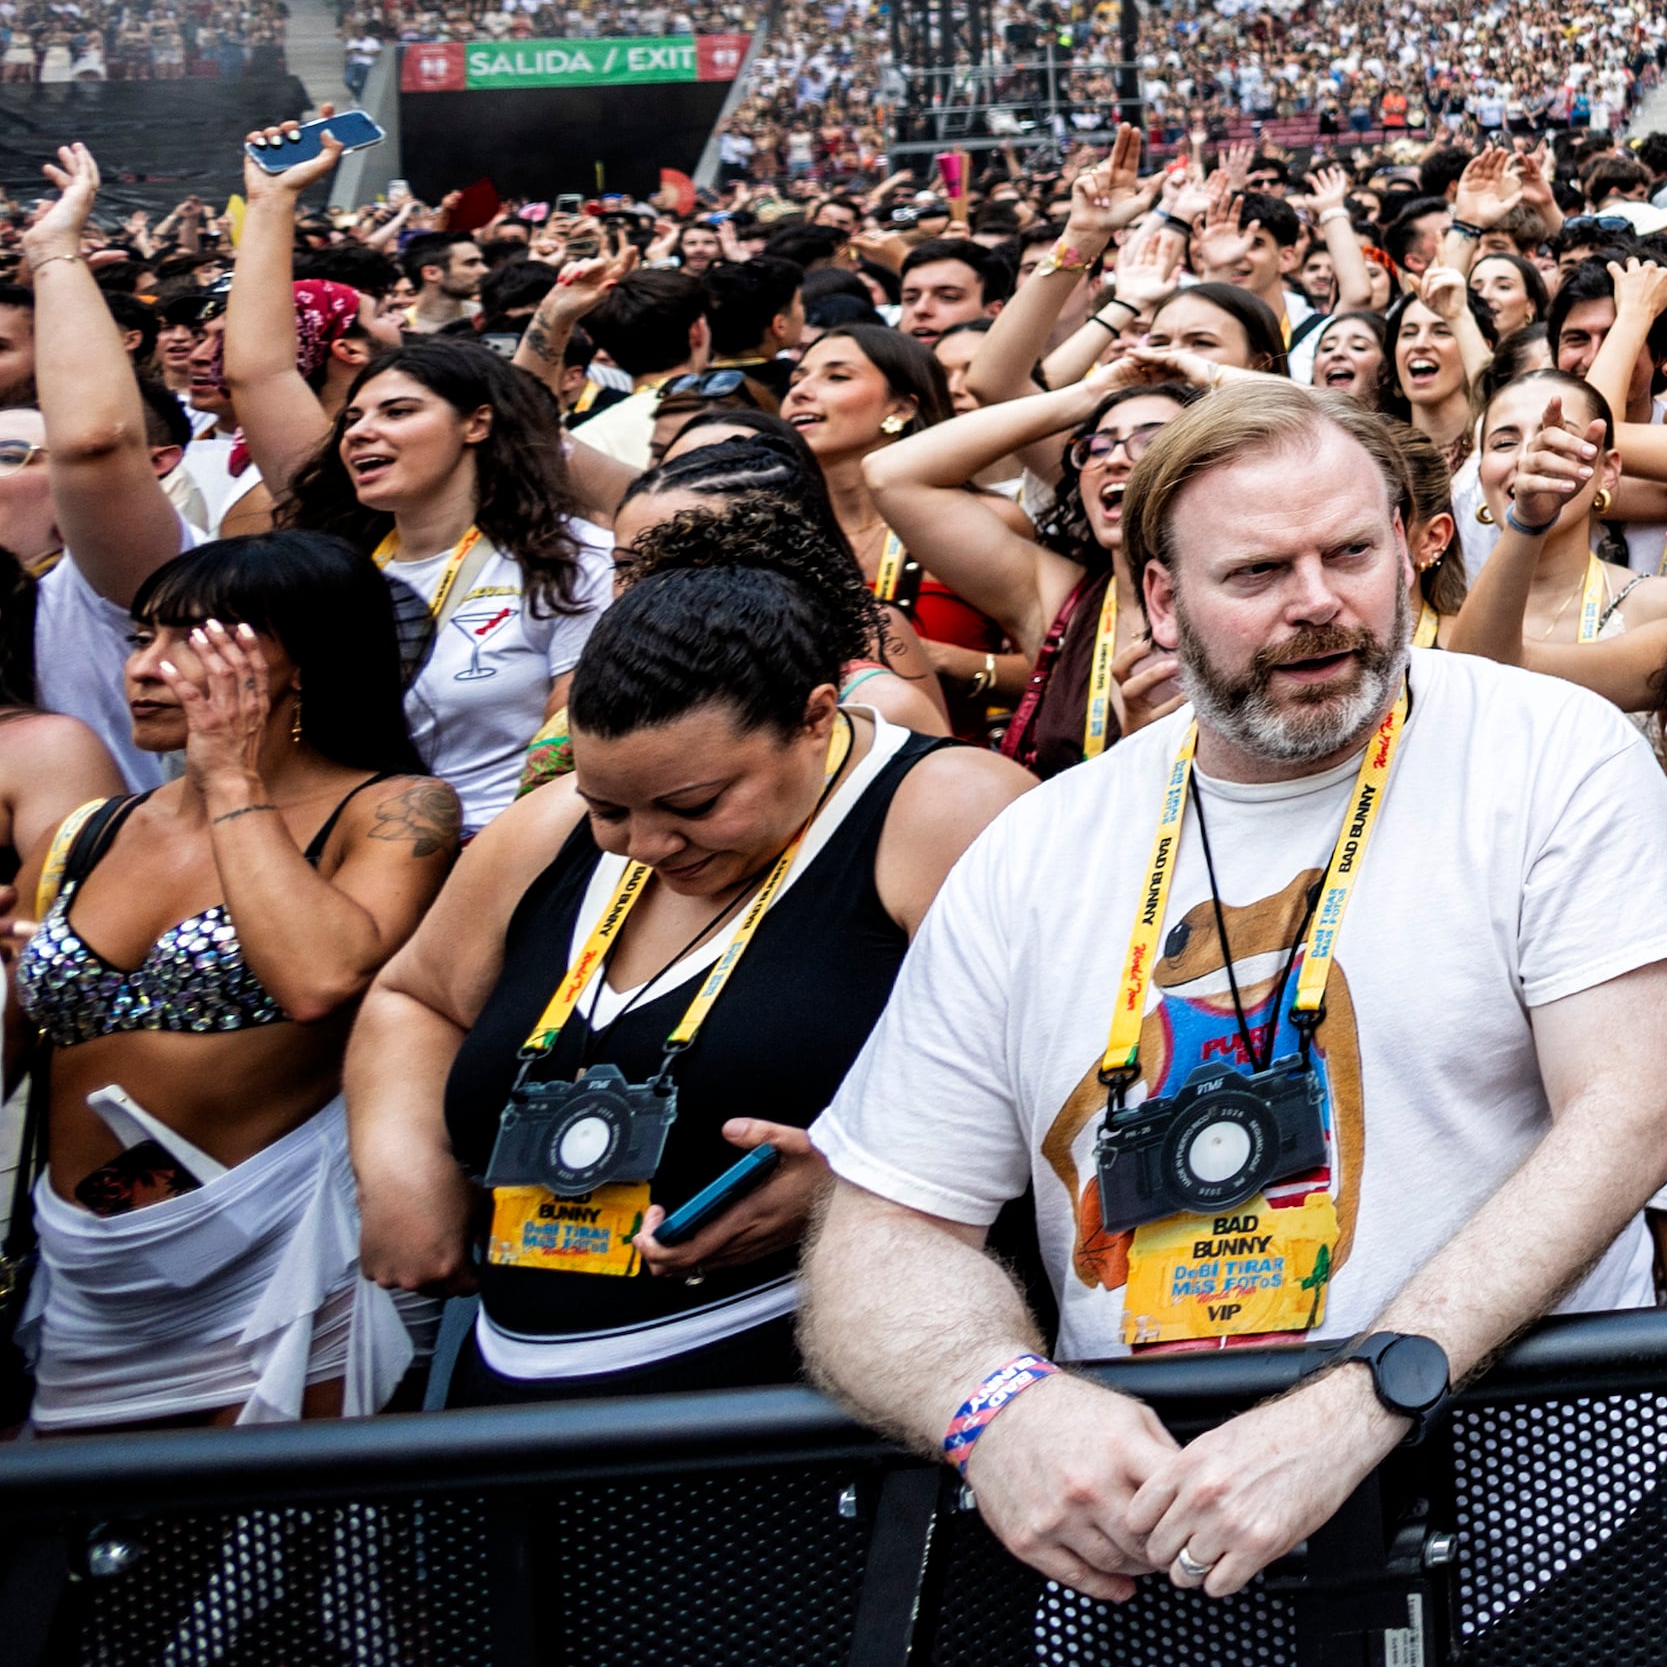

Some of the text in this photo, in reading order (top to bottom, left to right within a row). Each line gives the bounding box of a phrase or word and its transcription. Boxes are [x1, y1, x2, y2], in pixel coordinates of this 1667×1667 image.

[468, 50, 595, 76] SALIDA
[627, 45, 696, 72] EXIT
[1373, 712, 1394, 769] World Tour
[1338, 784, 1377, 873] BAD BUNNY
[1142, 837, 1172, 926] BAD BUNNY
[600, 866, 648, 937] BAD BUNNY
[539, 1203, 602, 1224] BUNNY
[1212, 1215, 1258, 1236] BAD
[1192, 1235, 1273, 1259] BUNNY
[1207, 1304, 1242, 1322] VIP
[970, 1356, 1038, 1414] BUNNY
[987, 1370, 1033, 1408] BAD
